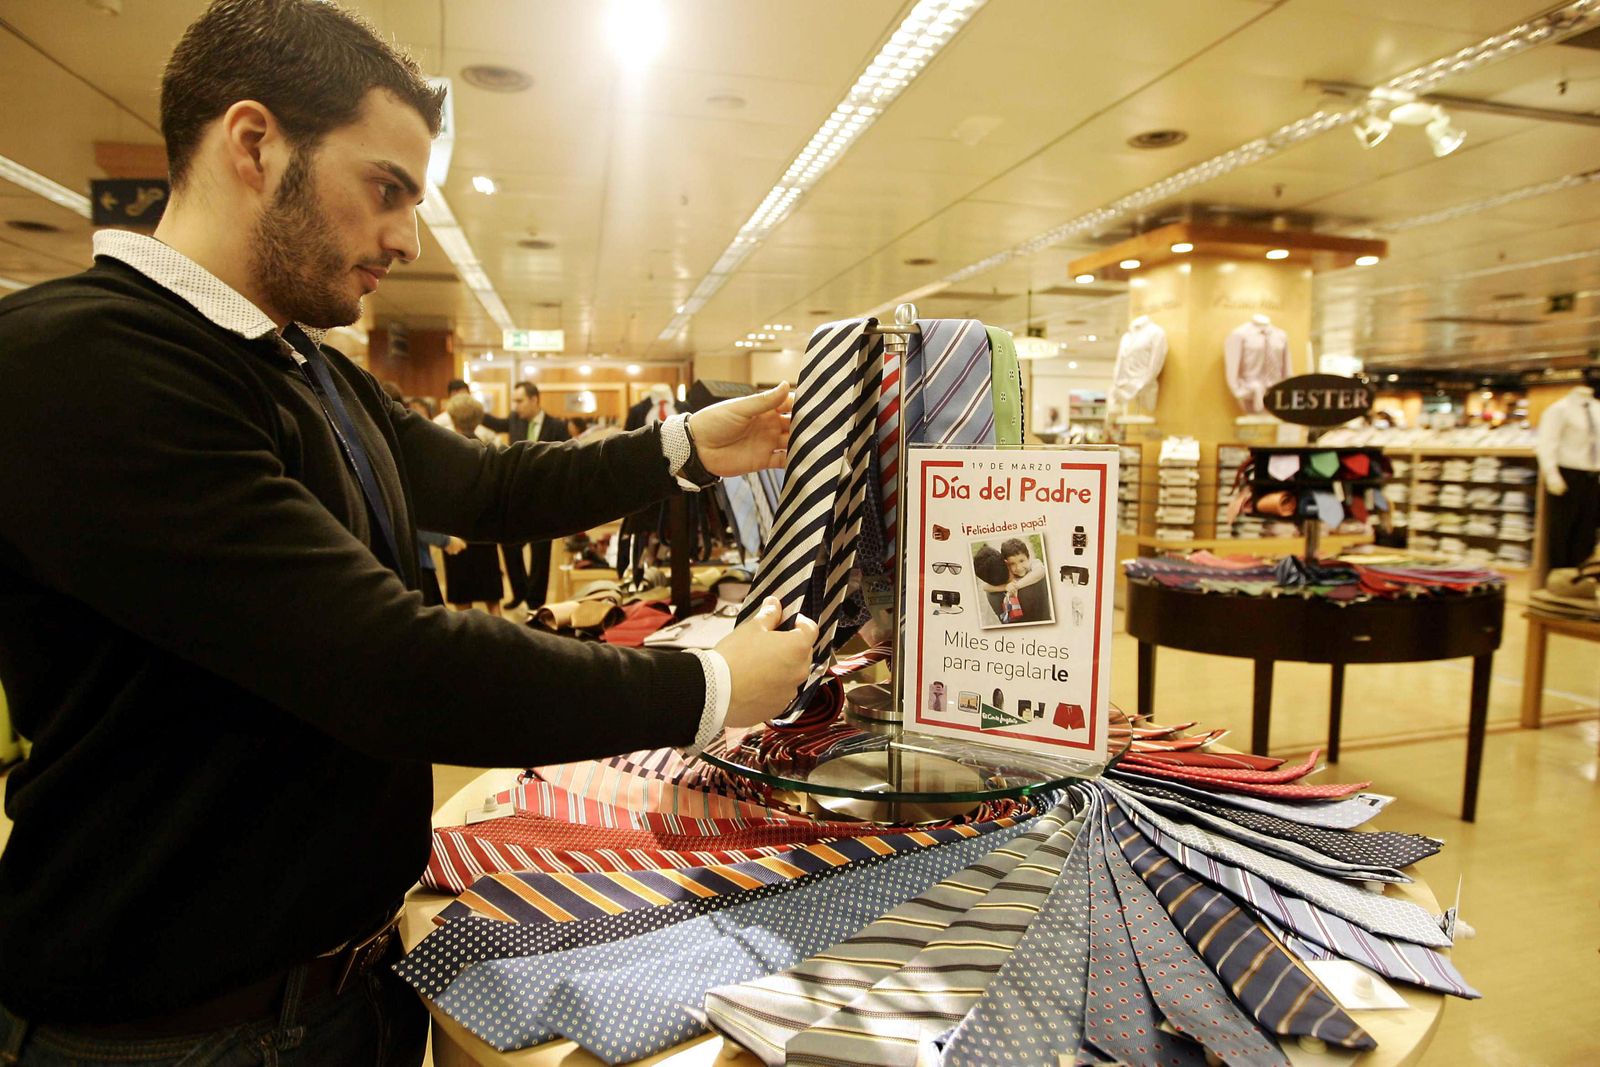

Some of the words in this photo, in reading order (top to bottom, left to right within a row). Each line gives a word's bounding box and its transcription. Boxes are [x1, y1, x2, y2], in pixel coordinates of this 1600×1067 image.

[1274, 388, 1370, 410] LESTER
[972, 462, 984, 470] 19
[990, 462, 1004, 470] DE
[1011, 463, 1052, 471] MARZO
[932, 474, 971, 500] Día
[979, 475, 1011, 501] del
[1020, 477, 1092, 504] Padre
[961, 522, 1018, 536] ¡Felicidades
[1020, 515, 1047, 533] papá!
[944, 629, 989, 651] Miles
[994, 635, 1016, 654] de
[1021, 638, 1069, 660] ideas
[943, 655, 981, 673] para
[986, 661, 1069, 683] regalarle
